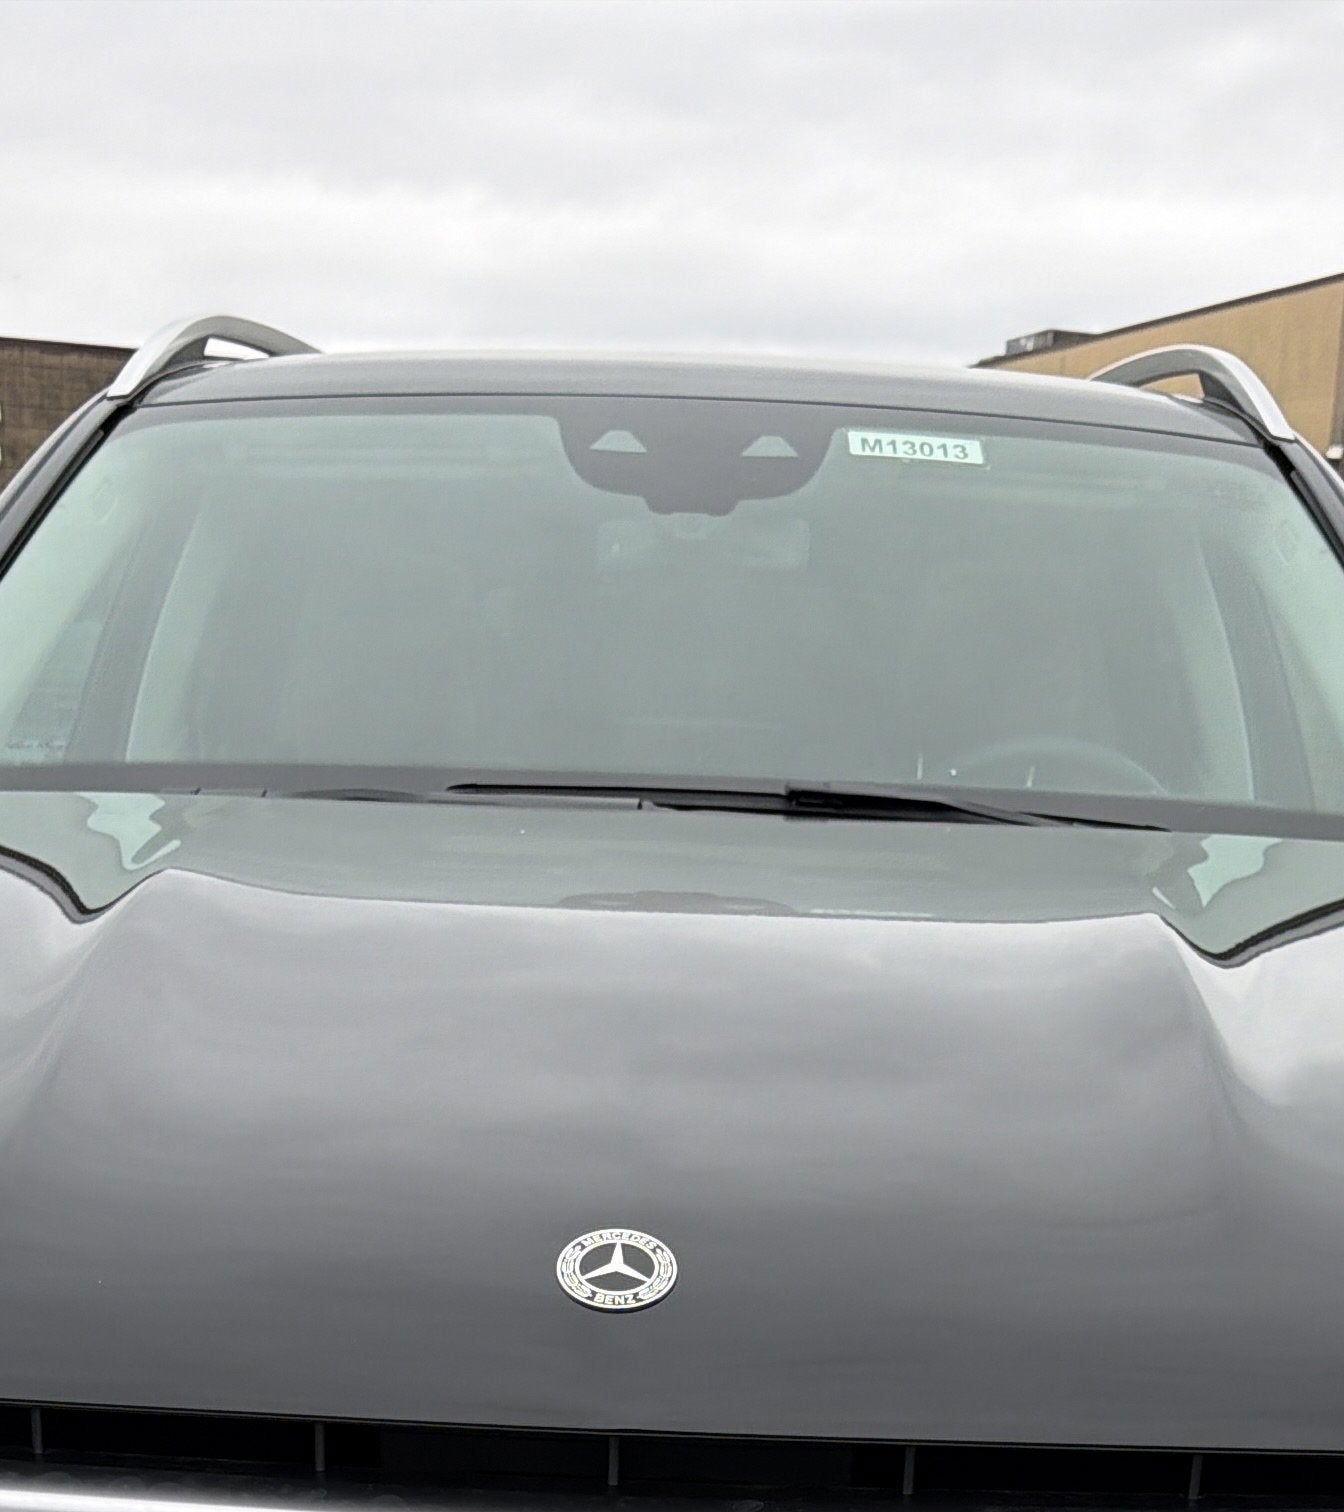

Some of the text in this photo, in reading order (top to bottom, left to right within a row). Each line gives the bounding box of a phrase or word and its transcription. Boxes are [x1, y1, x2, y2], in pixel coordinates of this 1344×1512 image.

[860, 437, 969, 460] M13013
[580, 1231, 658, 1250] MERCEDES
[594, 1293, 636, 1305] BENZ
